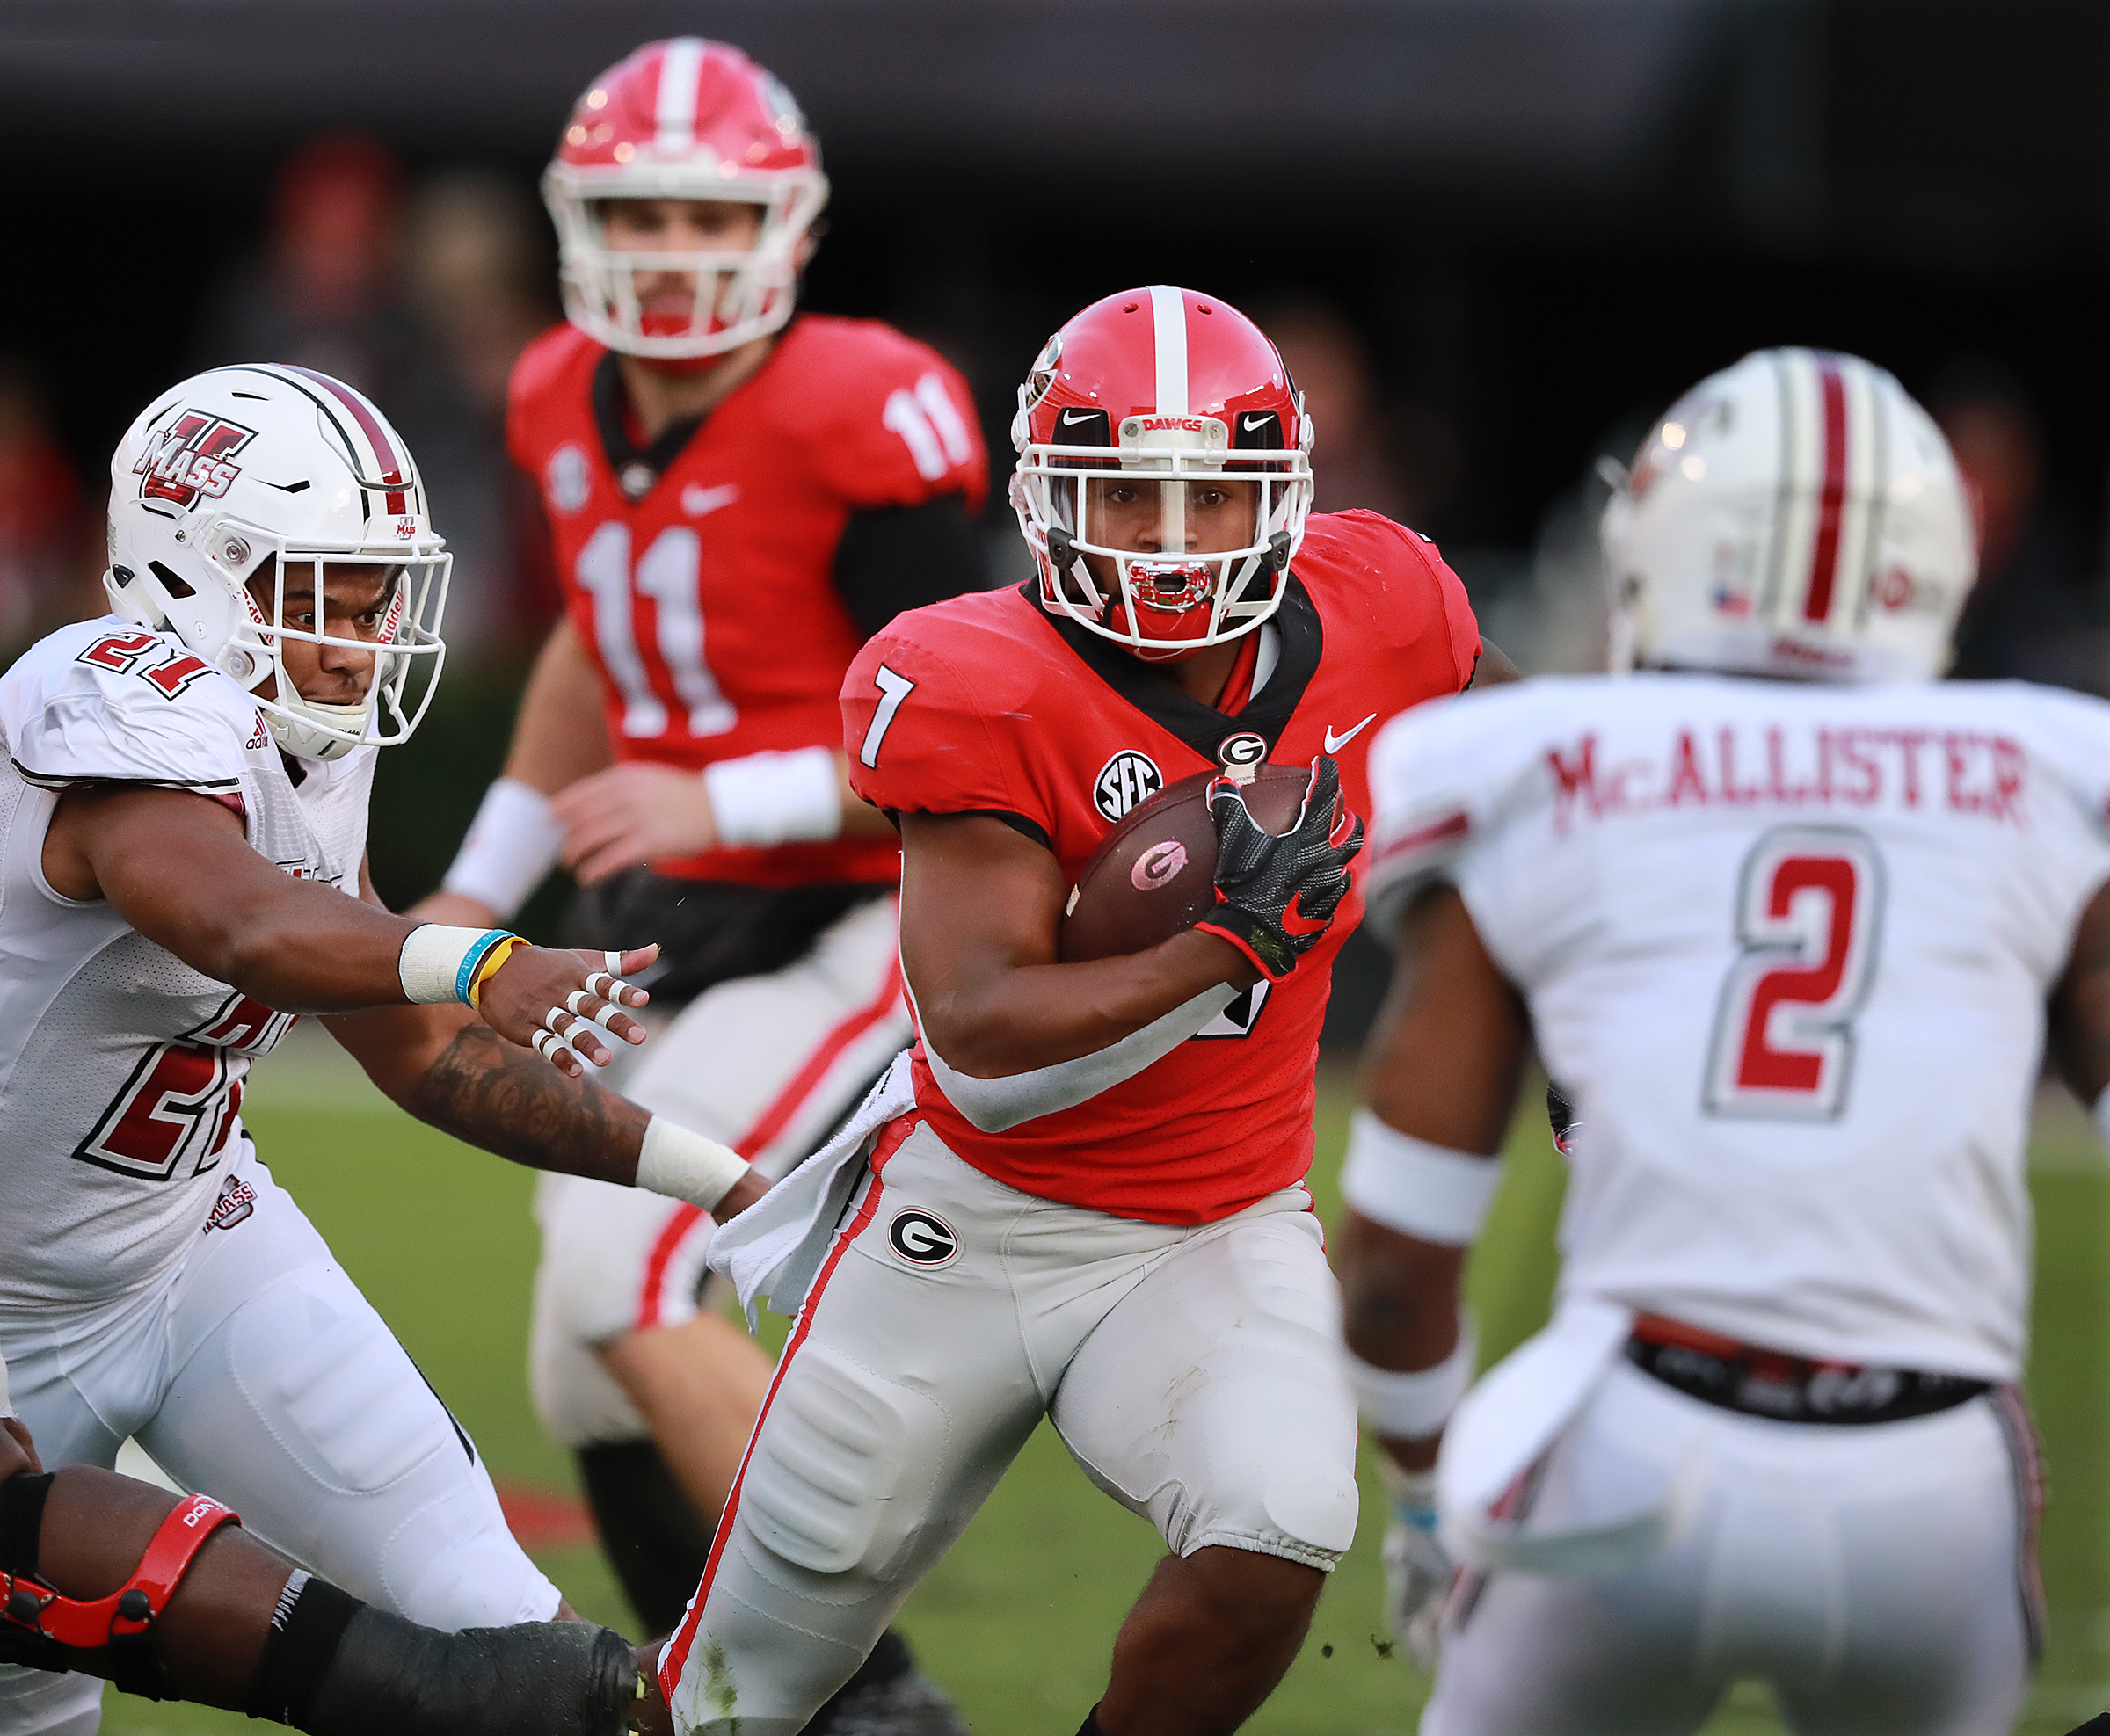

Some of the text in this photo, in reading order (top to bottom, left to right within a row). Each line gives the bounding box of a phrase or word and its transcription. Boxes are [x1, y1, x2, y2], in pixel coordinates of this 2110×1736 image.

[882, 372, 971, 479] 11
[1142, 418, 1203, 432] DAWGS
[574, 520, 738, 738] 11
[75, 631, 220, 701] 21
[860, 662, 917, 770] 7
[1219, 734, 1266, 765] G
[1545, 723, 2027, 839] McALLISTER
[1099, 756, 1156, 818] SEC
[1131, 840, 1187, 890] G
[462, 951, 476, 970] Just
[1699, 824, 1887, 1118] 2
[889, 1211, 957, 1263] G
